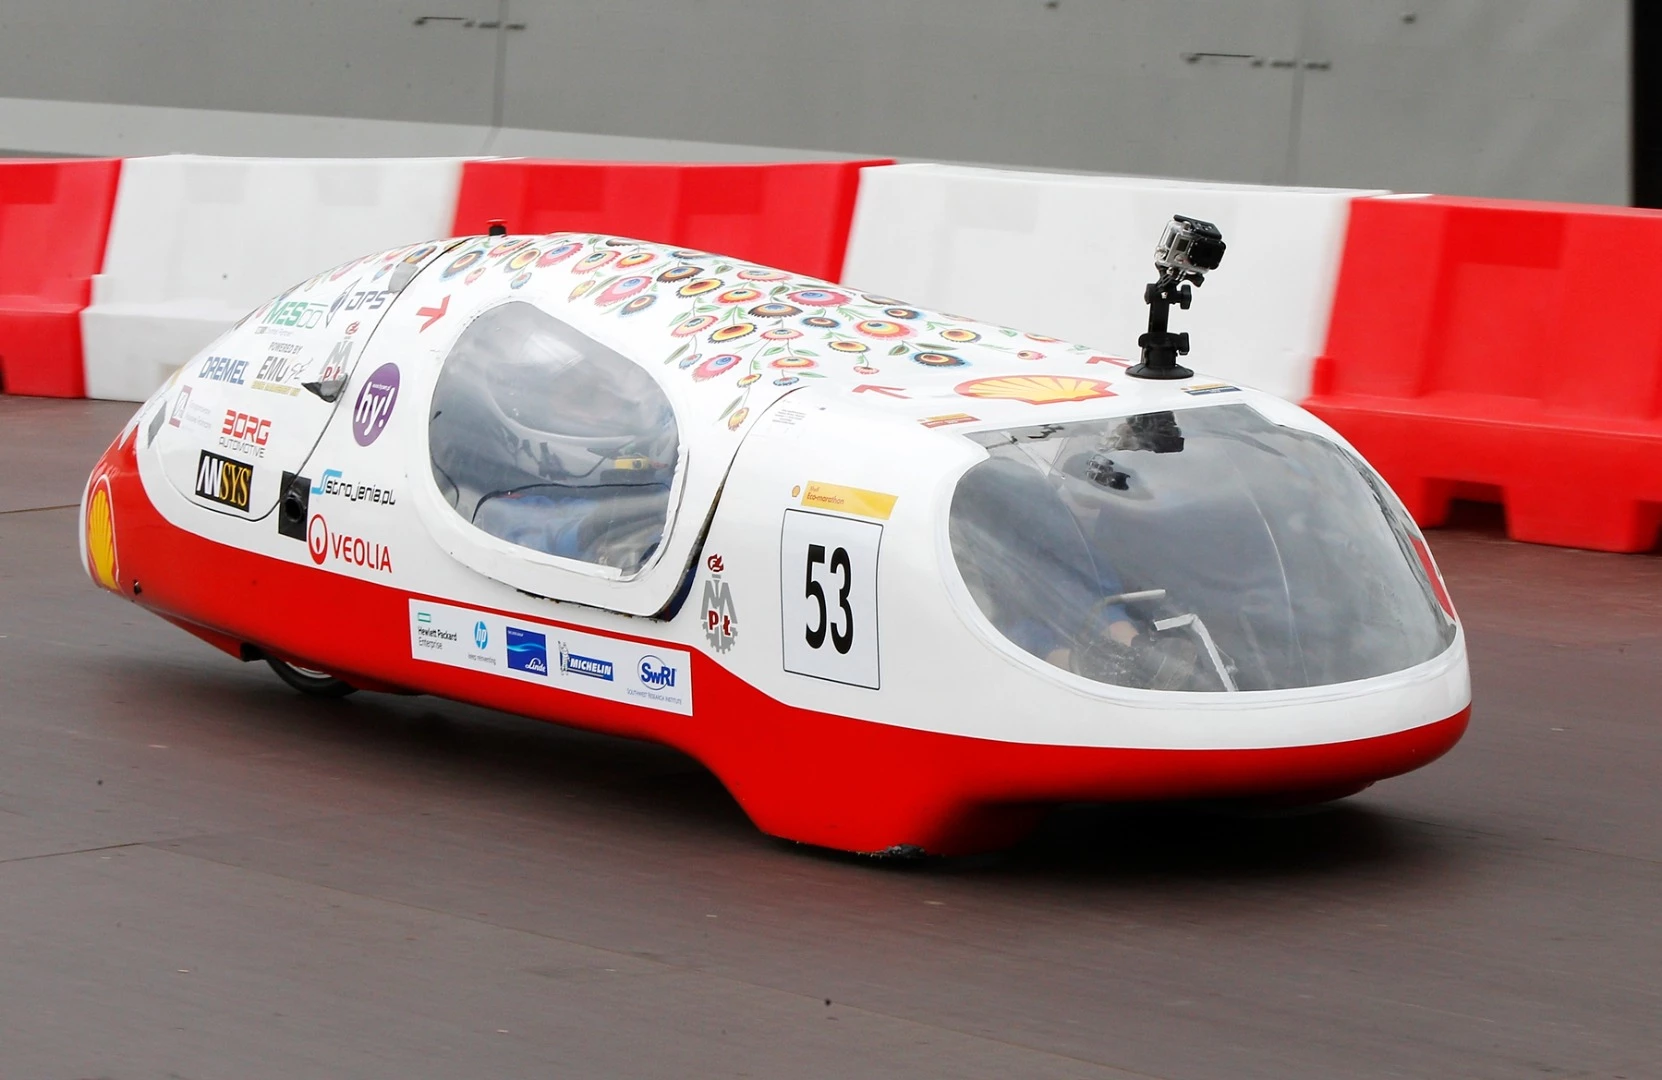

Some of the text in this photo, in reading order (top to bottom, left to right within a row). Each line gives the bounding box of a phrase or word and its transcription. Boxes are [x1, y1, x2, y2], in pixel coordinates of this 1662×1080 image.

[268, 341, 304, 355] POWERED BY
[198, 356, 249, 385] DREMEL
[355, 381, 395, 435] hy!
[222, 409, 272, 446] BORG
[219, 436, 266, 459] AUTOMOTIVE
[196, 455, 252, 507] ANSYS
[807, 492, 844, 505] Eco-marathon
[331, 532, 393, 573] VEOLIA
[805, 543, 854, 655] 53
[418, 627, 458, 642] Hewlett Packard
[419, 636, 443, 650] Enterprise
[475, 620, 488, 650] hp
[525, 657, 547, 673] Linde
[570, 658, 612, 676] MICHELIN
[641, 662, 676, 687] SwRI
